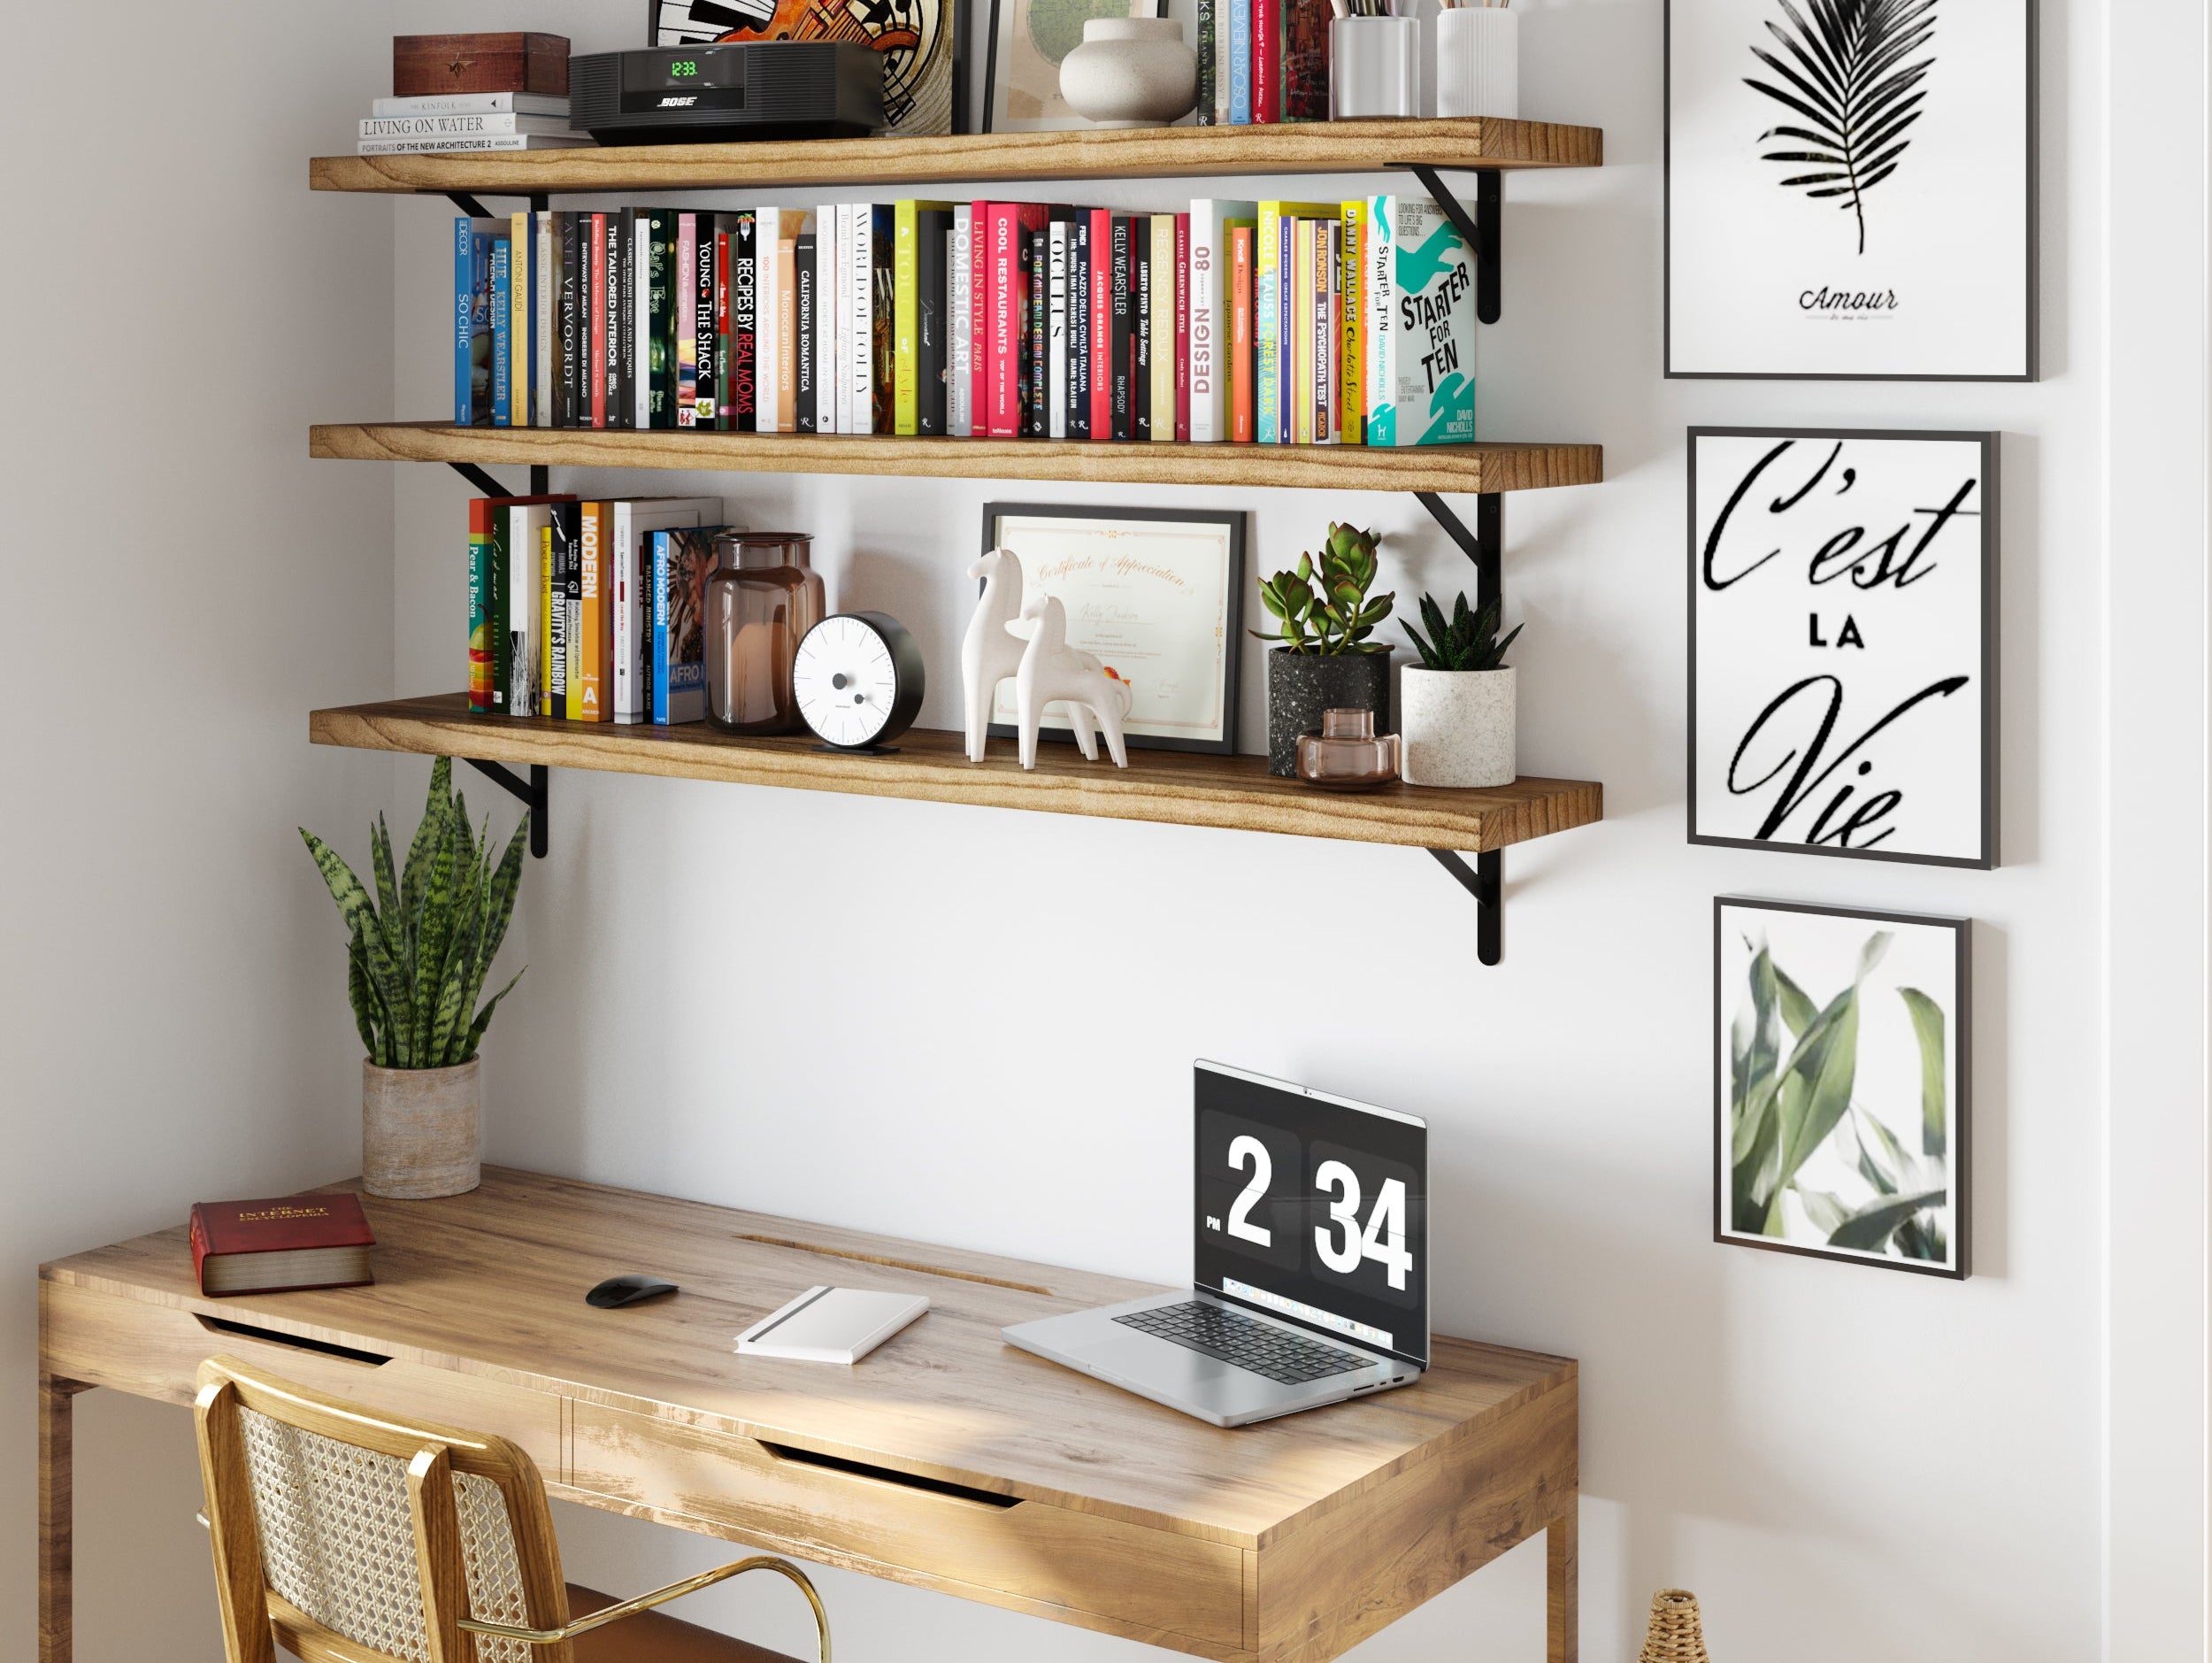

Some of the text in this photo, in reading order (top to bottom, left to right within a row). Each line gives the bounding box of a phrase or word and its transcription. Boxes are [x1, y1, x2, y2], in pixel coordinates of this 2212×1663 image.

[672, 61, 696, 77] 12:33
[1233, 58, 1246, 109] OSCAR
[365, 117, 484, 135] LIVING ON WATER
[657, 96, 698, 107] BOSE
[362, 143, 396, 152] PORTRAITS
[436, 141, 486, 150] ARCHITECTURE
[495, 247, 506, 278] HUE
[697, 241, 712, 289] YOUNG
[856, 212, 867, 293] WORLD
[1114, 225, 1126, 315] KELLY WEARSTLER
[1156, 228, 1169, 308] REGENCY
[1194, 246, 1210, 271] 80
[1317, 227, 1327, 293] JON RONSON
[1345, 209, 1357, 322] DANNY WALLACE
[1377, 246, 1390, 297] STARTER
[582, 284, 588, 294] OF
[608, 226, 617, 366] THE TAILORED INTERIOR
[956, 218, 970, 375] DOMESTIC ART
[974, 221, 984, 373] LIVING IN STYLE PARIS
[997, 218, 1008, 354] COOL RESTAURANTS
[1050, 239, 1064, 338] OCULUS
[1263, 210, 1274, 416] NICOLE KRAUSS FOREST DARK
[1401, 261, 1471, 331] STARTER
[1799, 286, 1899, 310] Amour
[459, 294, 469, 349] SO CHIC
[496, 291, 506, 401] KELLY WEARSTLER
[565, 277, 573, 389] VERVOORDT
[697, 301, 712, 381] THE SHACK
[738, 258, 753, 414] RECIPES BY REAL MOMS
[801, 270, 810, 393] CALIFORNIA ROMANTICA
[1033, 255, 1043, 411] POSTMODERN DESIGN COMPLETE
[1079, 325, 1088, 355] CIVILTÀ
[1140, 318, 1148, 338] Table
[1156, 310, 1169, 362] REDUX
[1376, 304, 1388, 332] TEN
[1429, 319, 1451, 350] FOR
[856, 331, 867, 393] FOLLY
[1138, 338, 1148, 366] Settings
[1194, 308, 1210, 394] DESIGN
[1317, 302, 1327, 407] THE PSYCHOPATH TEST
[1345, 327, 1356, 412] Charlotte Street
[1421, 338, 1459, 395] TEN
[1117, 375, 1125, 414] RHAPSODY
[1456, 409, 1473, 421] DAVID
[1446, 420, 1473, 434] NICHOLLS
[1703, 439, 1980, 591] C'est
[469, 545, 479, 619] Pear & Bacon
[582, 515, 597, 598] MODERN
[657, 544, 665, 626] AFRO MODERN
[1039, 551, 1186, 587] Certificate of Appreciation
[551, 590, 566, 696] GRAVITY'S RAINBOW
[1809, 612, 1864, 650] LA
[582, 686, 597, 704] A
[670, 665, 700, 683] AFRO
[1728, 674, 1970, 848] Vie
[240, 1207, 326, 1218] INTERNET
[1206, 1215, 1221, 1232] PM
[1227, 1135, 1413, 1291] 2 34
